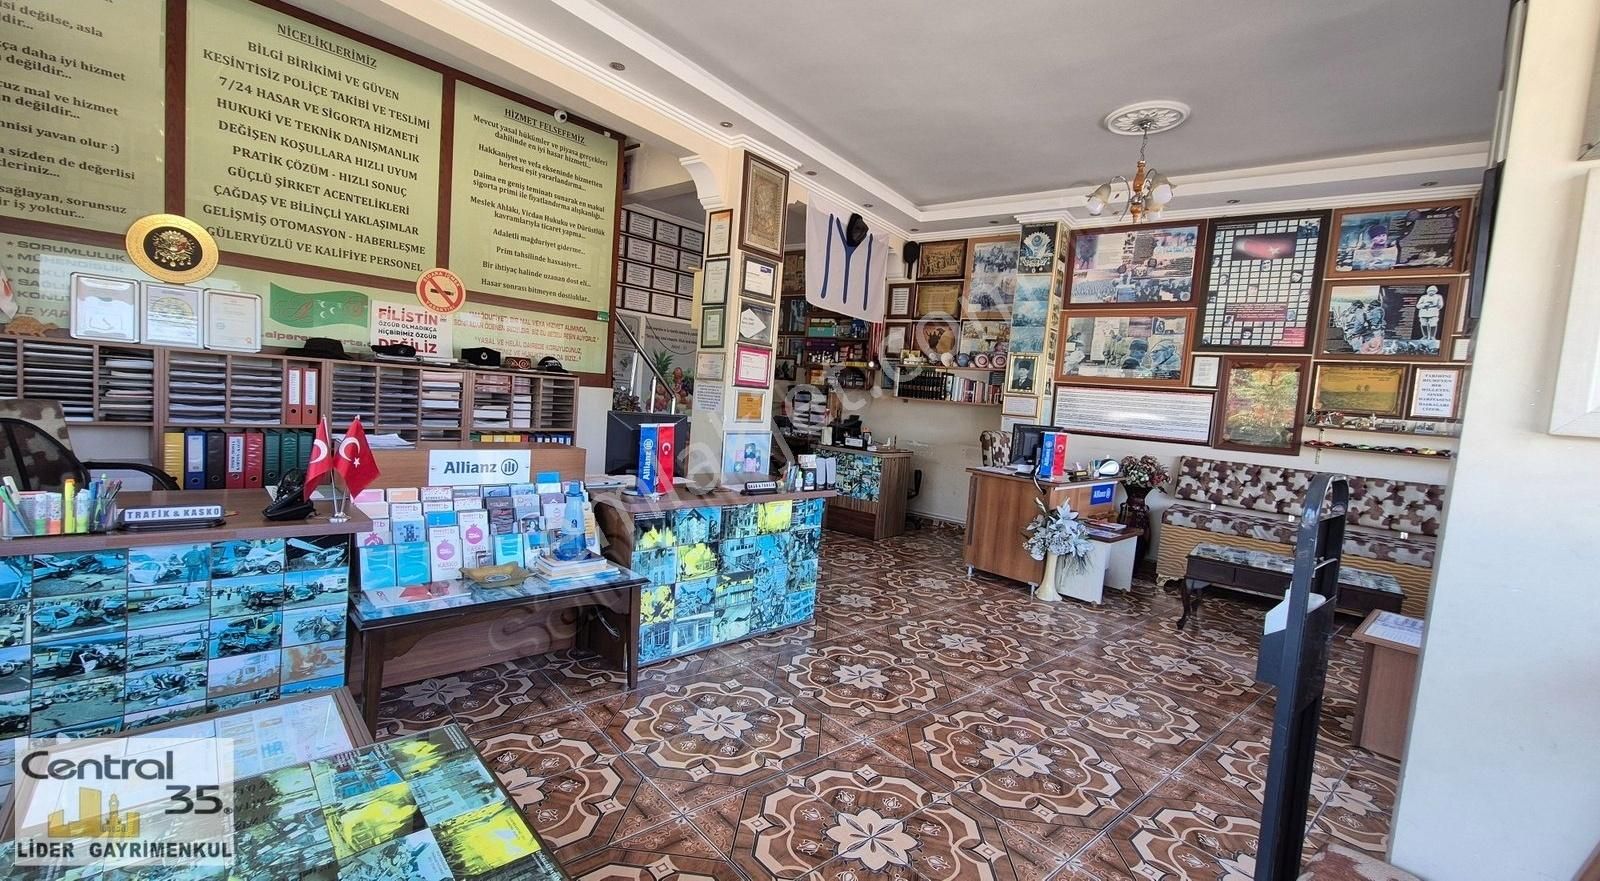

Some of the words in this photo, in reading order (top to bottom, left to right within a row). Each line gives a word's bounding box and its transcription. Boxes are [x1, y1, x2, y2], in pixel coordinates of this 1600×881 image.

[19, 5, 73, 30] değilse,
[76, 24, 103, 38] asla
[277, 23, 377, 66] NİCELİKLERİMİZ
[22, 46, 57, 62] daha
[60, 55, 77, 68] iyi
[80, 61, 125, 82] hizmet
[248, 41, 283, 62] BİLGİ
[287, 55, 342, 81] BİRİKİMİ
[345, 74, 360, 88] VE
[362, 81, 399, 101] GÜVEN
[24, 86, 50, 99] mal
[54, 94, 69, 104] ve
[73, 96, 118, 116] hizmet
[203, 49, 280, 81] KESİNTİSİZ
[283, 73, 327, 97] POLİÇE
[330, 88, 369, 110] TAKİBİ
[372, 103, 386, 116] VE
[388, 108, 430, 130] TESLİMİ
[217, 97, 271, 122] HUKUKİ
[275, 114, 292, 127] VE
[294, 119, 341, 141] TEKNİK
[344, 133, 419, 163] DANIŞMANLIK
[256, 87, 301, 109] HASAR
[303, 101, 319, 115] VE
[321, 107, 371, 130] SİGORTA
[373, 123, 418, 144] HİZMETİ
[36, 128, 76, 143] yavan
[79, 138, 108, 150] olur
[219, 120, 276, 144] DEĞİŞEN
[280, 136, 352, 164] KOŞULLARA
[355, 156, 384, 172] HIZLI
[387, 165, 417, 181] UYUM
[8, 148, 55, 164] sizden
[58, 157, 76, 168] de
[78, 161, 135, 180] değerlisi
[233, 145, 283, 167] PRATİK
[286, 159, 329, 178] ÇÖZÜM
[339, 172, 369, 188] HIZLI
[371, 180, 407, 198] SONUÇ
[0, 185, 63, 204] sağlayan,
[66, 197, 127, 214] sorunsuz
[14, 199, 26, 211] iş
[228, 166, 272, 184] GÜÇLÜ
[275, 176, 321, 195] ŞİRKET
[323, 188, 409, 215] ACENTELİKLERİ
[213, 184, 267, 206] ÇAĞDAŞ
[270, 196, 287, 208] VE
[290, 200, 341, 220] BİLİNÇLİ
[344, 212, 419, 236] YAKLAŞIMLAR
[203, 204, 267, 227] GELİŞMİŞ
[270, 217, 346, 240] OTOMASYON
[355, 233, 425, 255] HABERLEŞME
[17, 241, 126, 262] SORUMLULUK
[209, 225, 293, 250] GÜLERYÜZLÜ
[296, 242, 312, 253] VE
[315, 245, 367, 263] KALİFİYE
[370, 255, 423, 272] PERSONEL
[379, 306, 438, 325] FİLİSTİN
[415, 332, 437, 340] ÖZGÜR
[443, 461, 497, 475] Allianz
[642, 450, 652, 480] Allianz
[127, 508, 170, 519] TRAFİK
[183, 507, 220, 517] KASKO
